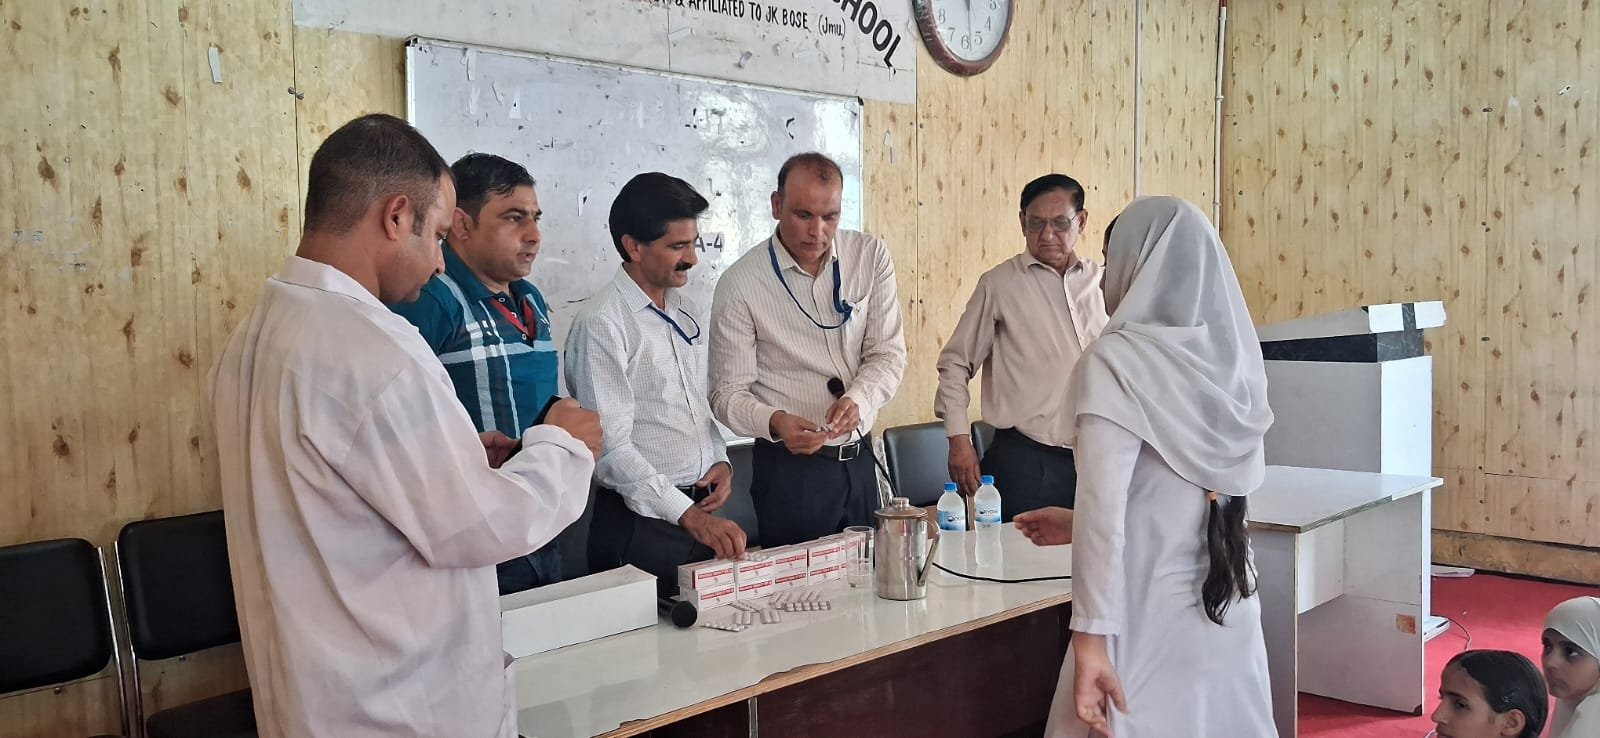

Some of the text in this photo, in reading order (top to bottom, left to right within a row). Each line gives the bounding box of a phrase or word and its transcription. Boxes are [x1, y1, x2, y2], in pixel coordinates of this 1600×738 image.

[689, 0, 744, 17] AFFILIATED
[749, 2, 761, 21] TO
[766, 6, 778, 25] JK
[783, 8, 808, 29] BOSE
[938, 8, 946, 24] 8
[984, 15, 991, 31] 4
[948, 27, 956, 42] 7
[975, 31, 983, 46] 5
[961, 35, 970, 50] 6
